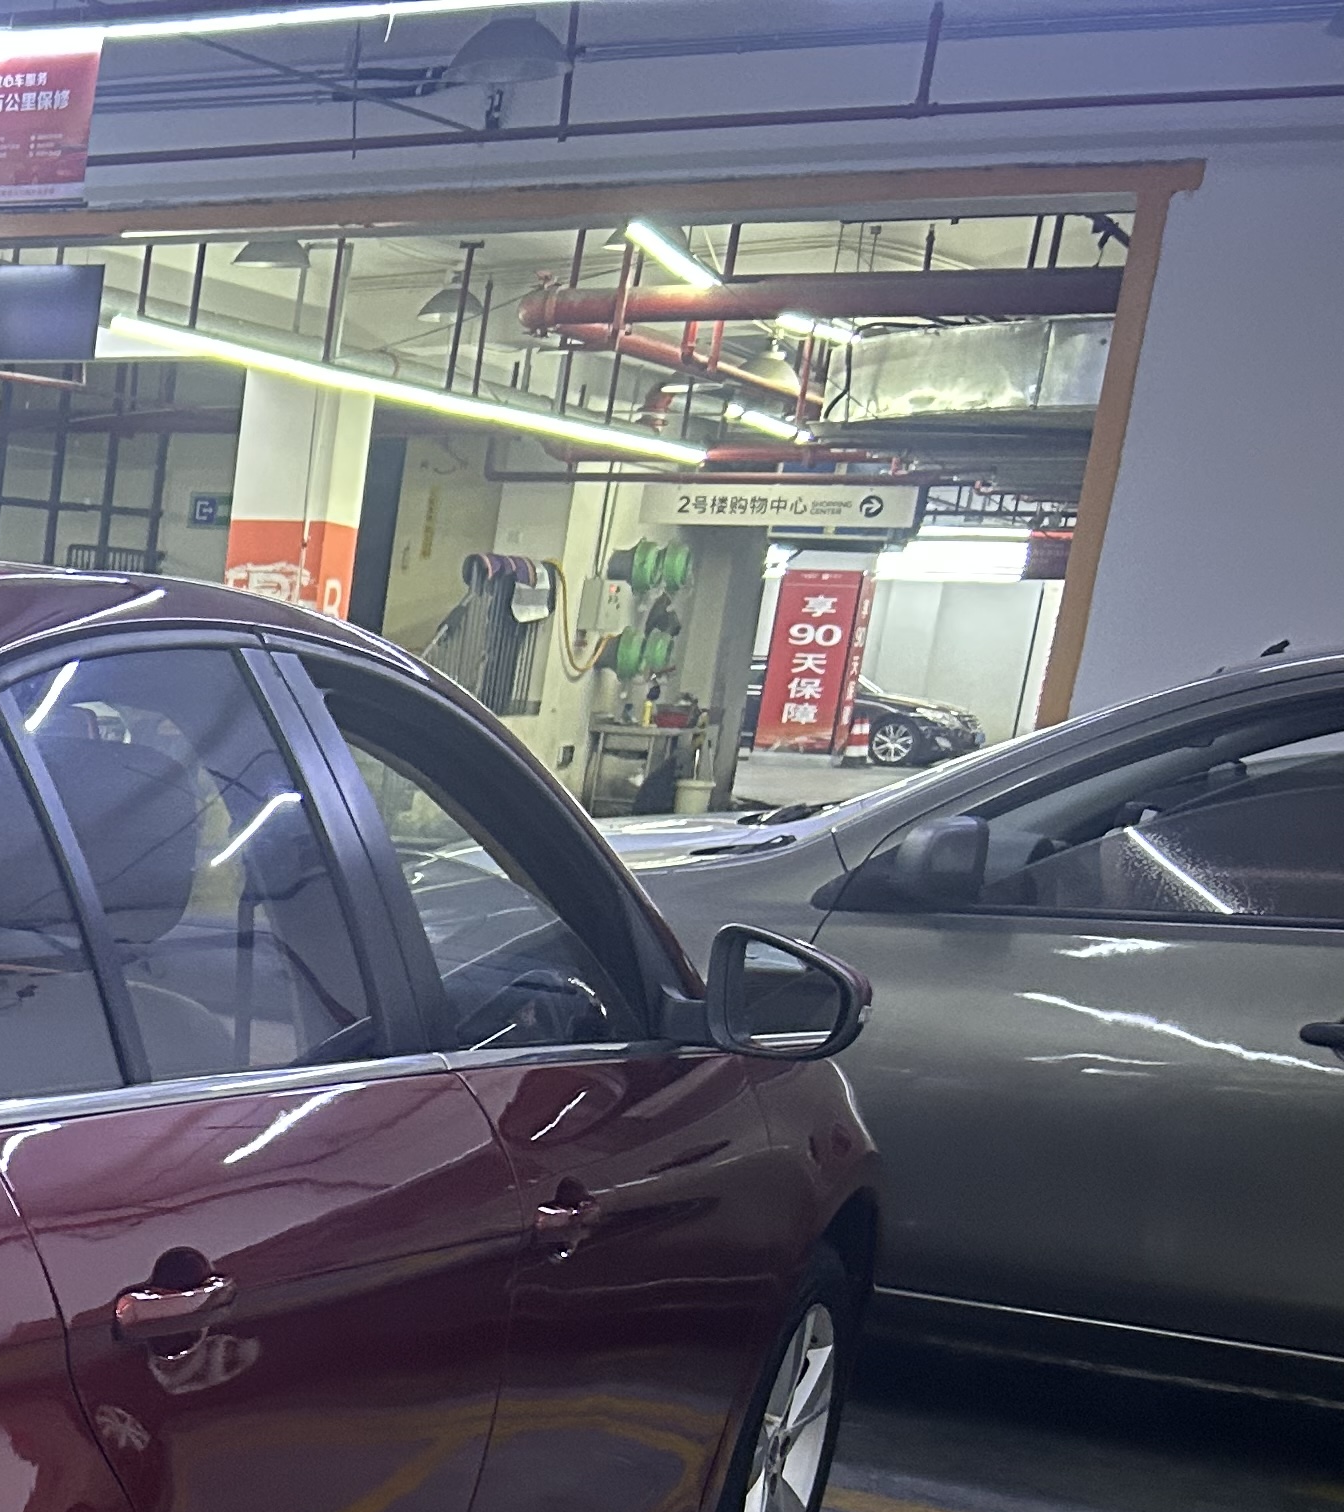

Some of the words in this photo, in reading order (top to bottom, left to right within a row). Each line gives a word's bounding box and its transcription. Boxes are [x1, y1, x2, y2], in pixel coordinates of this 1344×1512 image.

[676, 495, 808, 516] 2号楼购物中心
